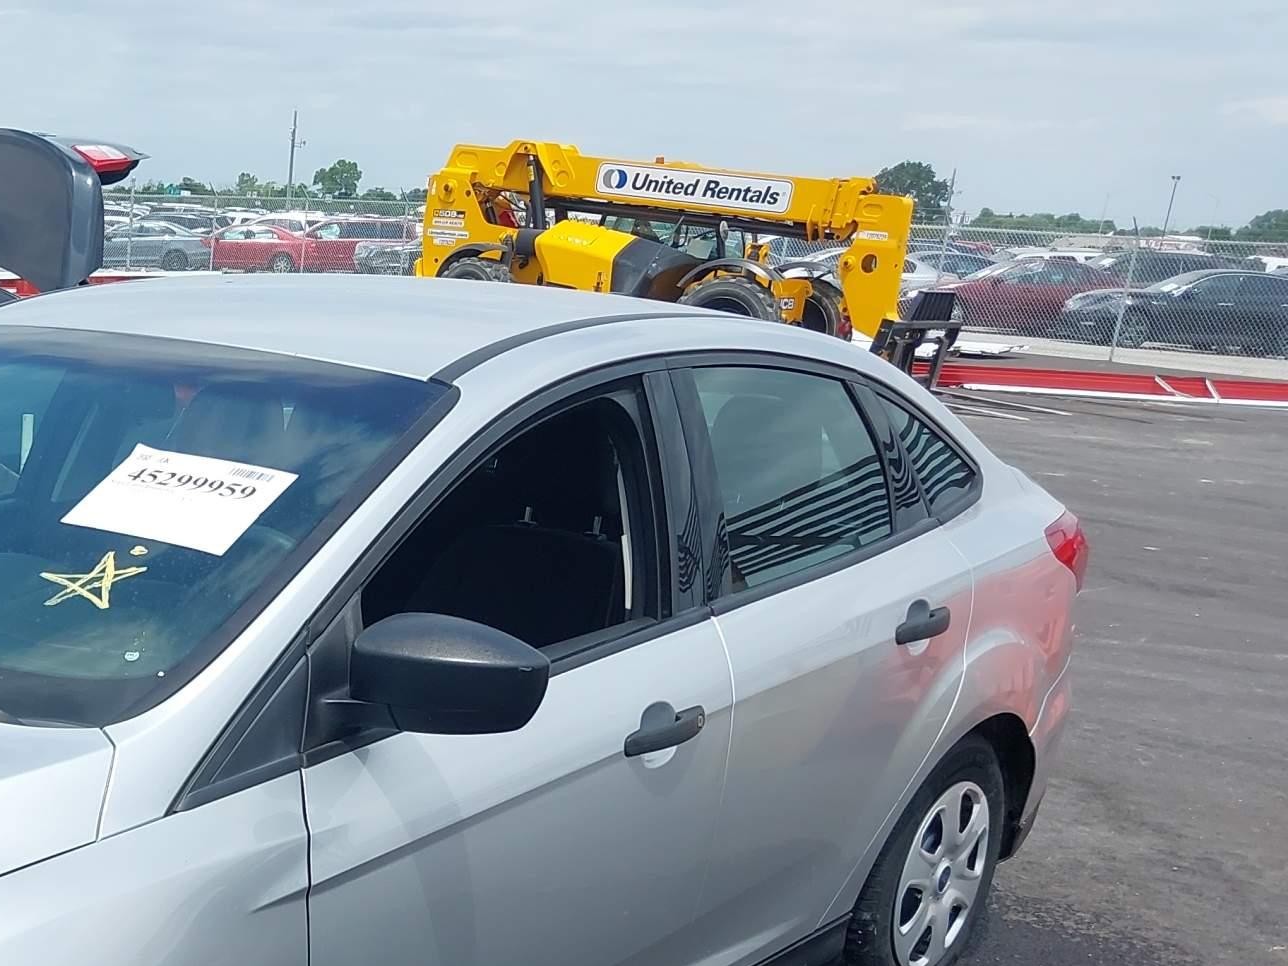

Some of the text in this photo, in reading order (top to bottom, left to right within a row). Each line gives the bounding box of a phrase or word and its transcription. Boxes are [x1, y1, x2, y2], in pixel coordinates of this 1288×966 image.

[631, 172, 781, 205] United Rentals
[127, 467, 257, 500] 45299959
